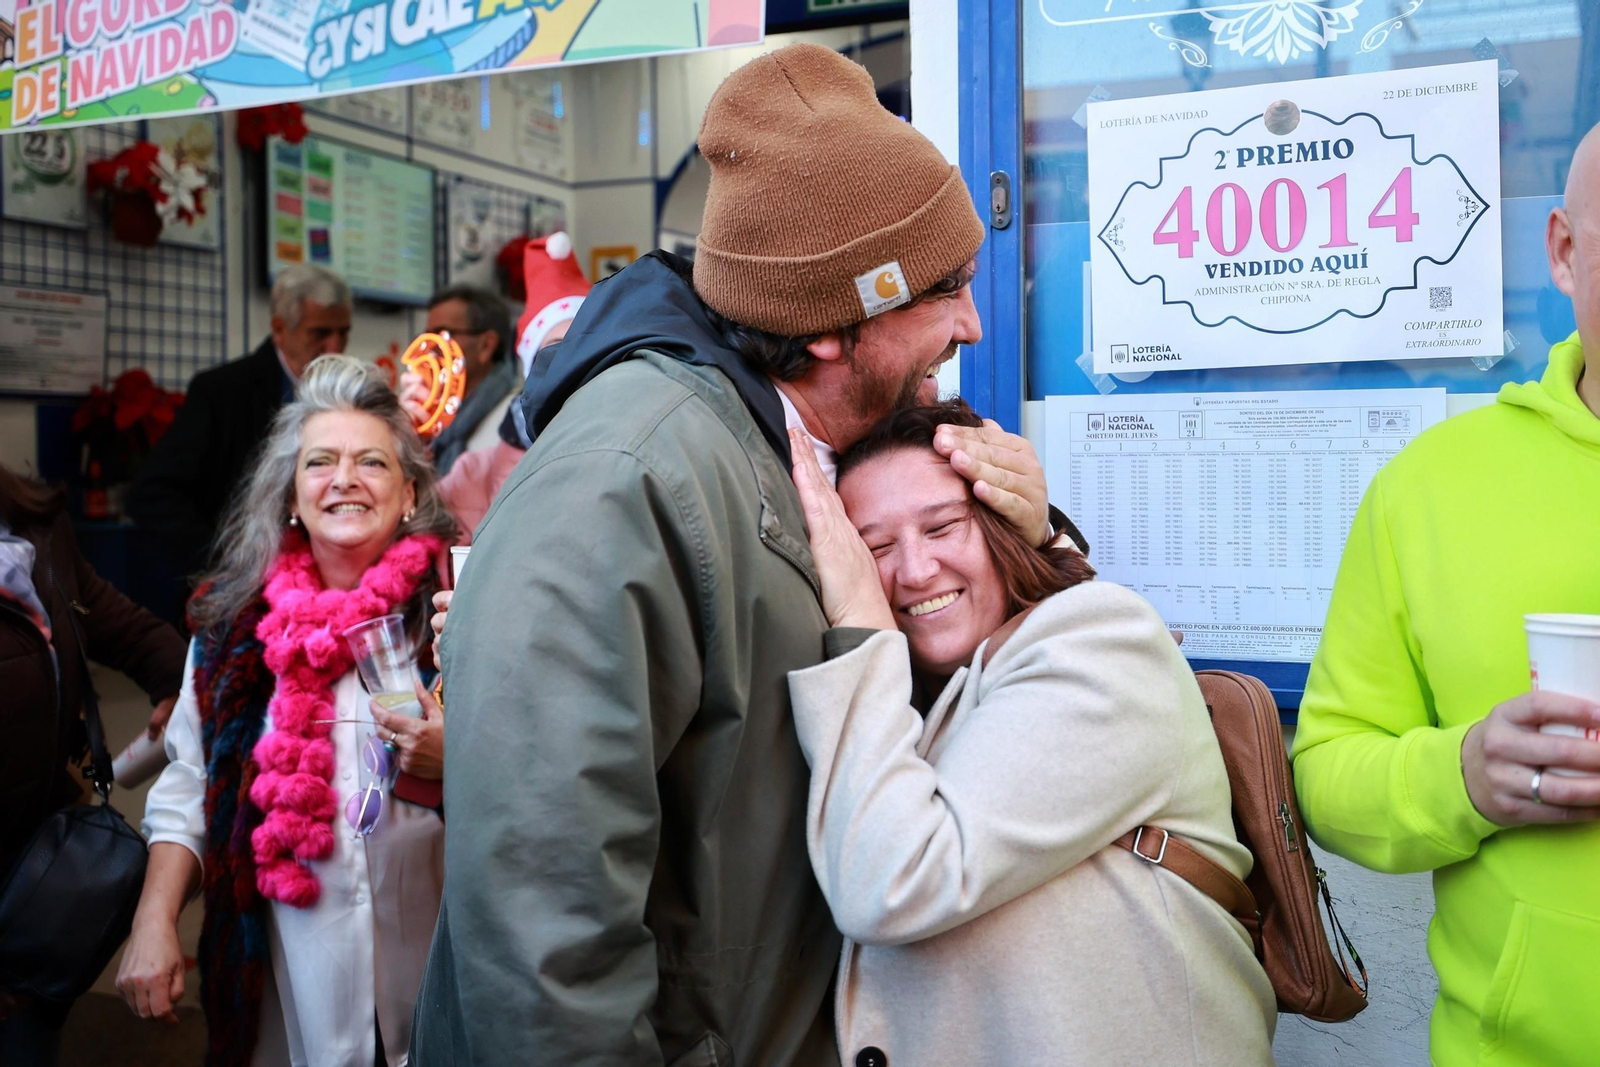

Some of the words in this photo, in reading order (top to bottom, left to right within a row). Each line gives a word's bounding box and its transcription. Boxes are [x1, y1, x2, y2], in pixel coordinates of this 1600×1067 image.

[17, 3, 59, 64] EL
[15, 65, 60, 122] DE
[67, 9, 235, 104] NAVIDAD
[1383, 90, 1394, 100] 22
[1397, 88, 1412, 98] DE
[1415, 82, 1478, 96] DICIEMBRE
[1100, 115, 1142, 128] LOTERÍA
[1145, 114, 1158, 124] DE
[1160, 110, 1208, 122] NAVIDAD
[1236, 138, 1354, 168] PREMIO
[1153, 166, 1420, 258] 40014
[1204, 257, 1304, 279] VENDIDO
[1310, 248, 1368, 275] AQUÍ
[1194, 281, 1285, 296] ADMINISTRACIÓN
[1300, 279, 1325, 290] SRA.
[1328, 278, 1342, 288] DE
[1344, 276, 1381, 286] REGLA
[1260, 294, 1312, 306] CHIPIONA
[1404, 318, 1482, 330] COMPARTIRLO
[1132, 344, 1172, 354] LOTERÍA
[1405, 338, 1482, 348] EXTRAORDINARIO
[1132, 353, 1182, 362] NACIONAL
[1108, 414, 1145, 423] LOTERÍA
[1084, 443, 1091, 451] 0
[1119, 443, 1122, 451] 1
[1152, 442, 1158, 451] 2
[1186, 442, 1192, 450] 3
[1220, 441, 1226, 450] 4
[1255, 440, 1260, 449] 5
[1290, 440, 1297, 449] 6
[1326, 440, 1333, 449] 7
[1362, 439, 1370, 448] 8
[1400, 439, 1406, 448] 9
